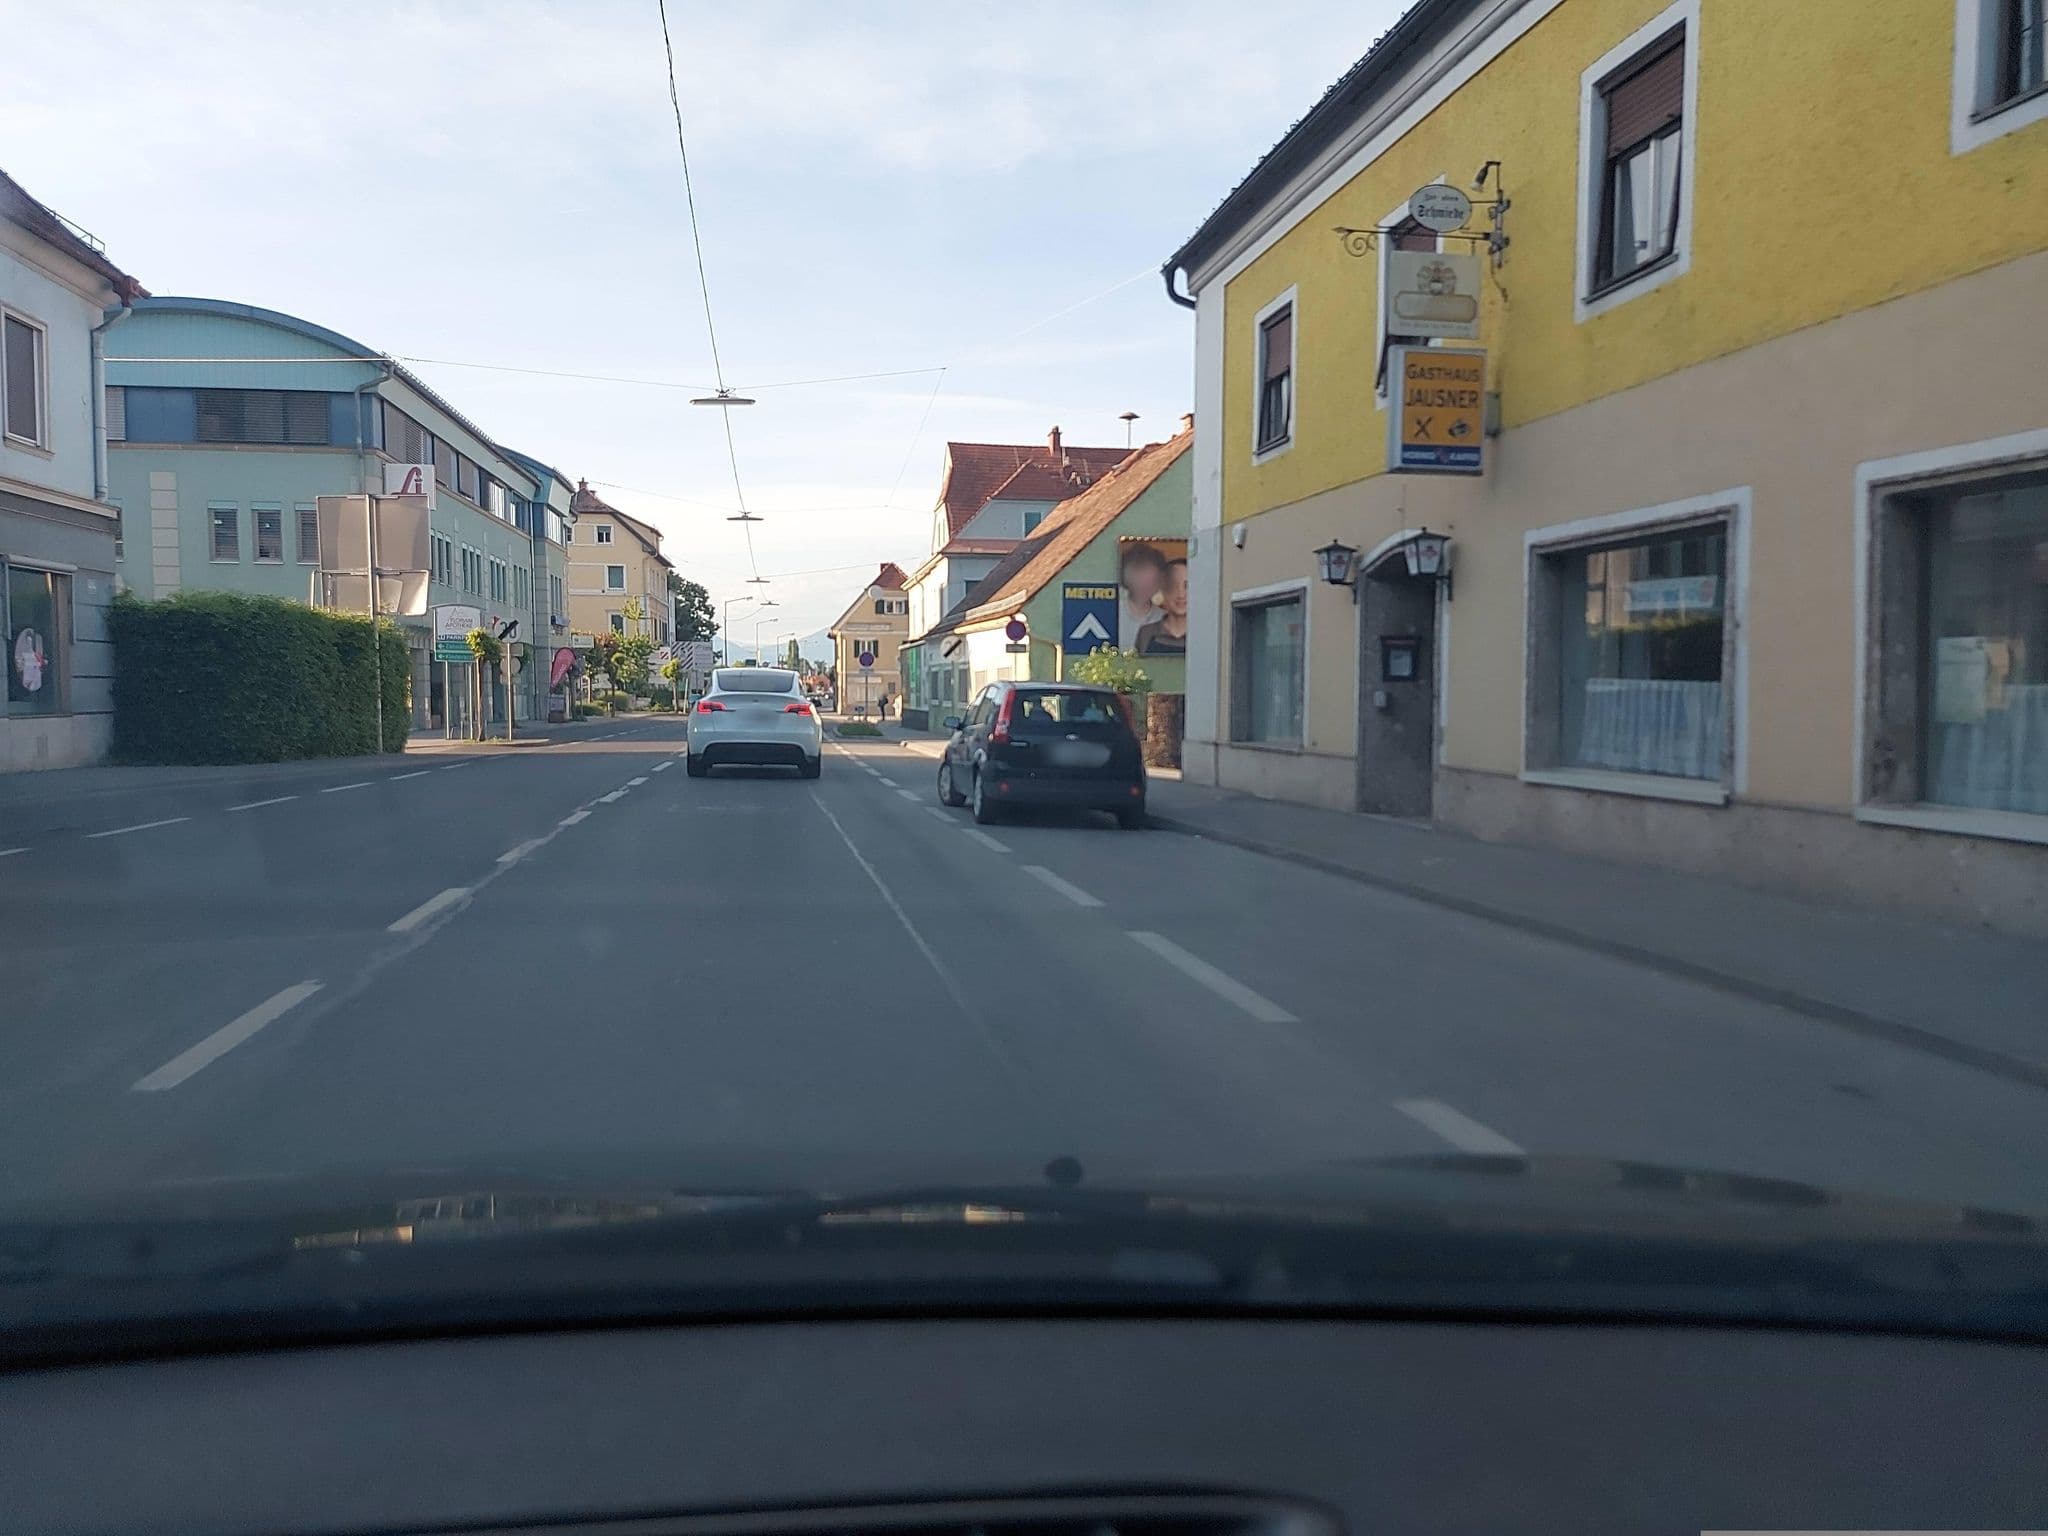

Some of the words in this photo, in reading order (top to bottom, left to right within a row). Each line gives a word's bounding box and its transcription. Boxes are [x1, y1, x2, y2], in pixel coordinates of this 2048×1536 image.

[1407, 364, 1480, 383] GASTHAUS
[1405, 388, 1479, 409] JAUSNER
[1064, 586, 1117, 600] METRO
